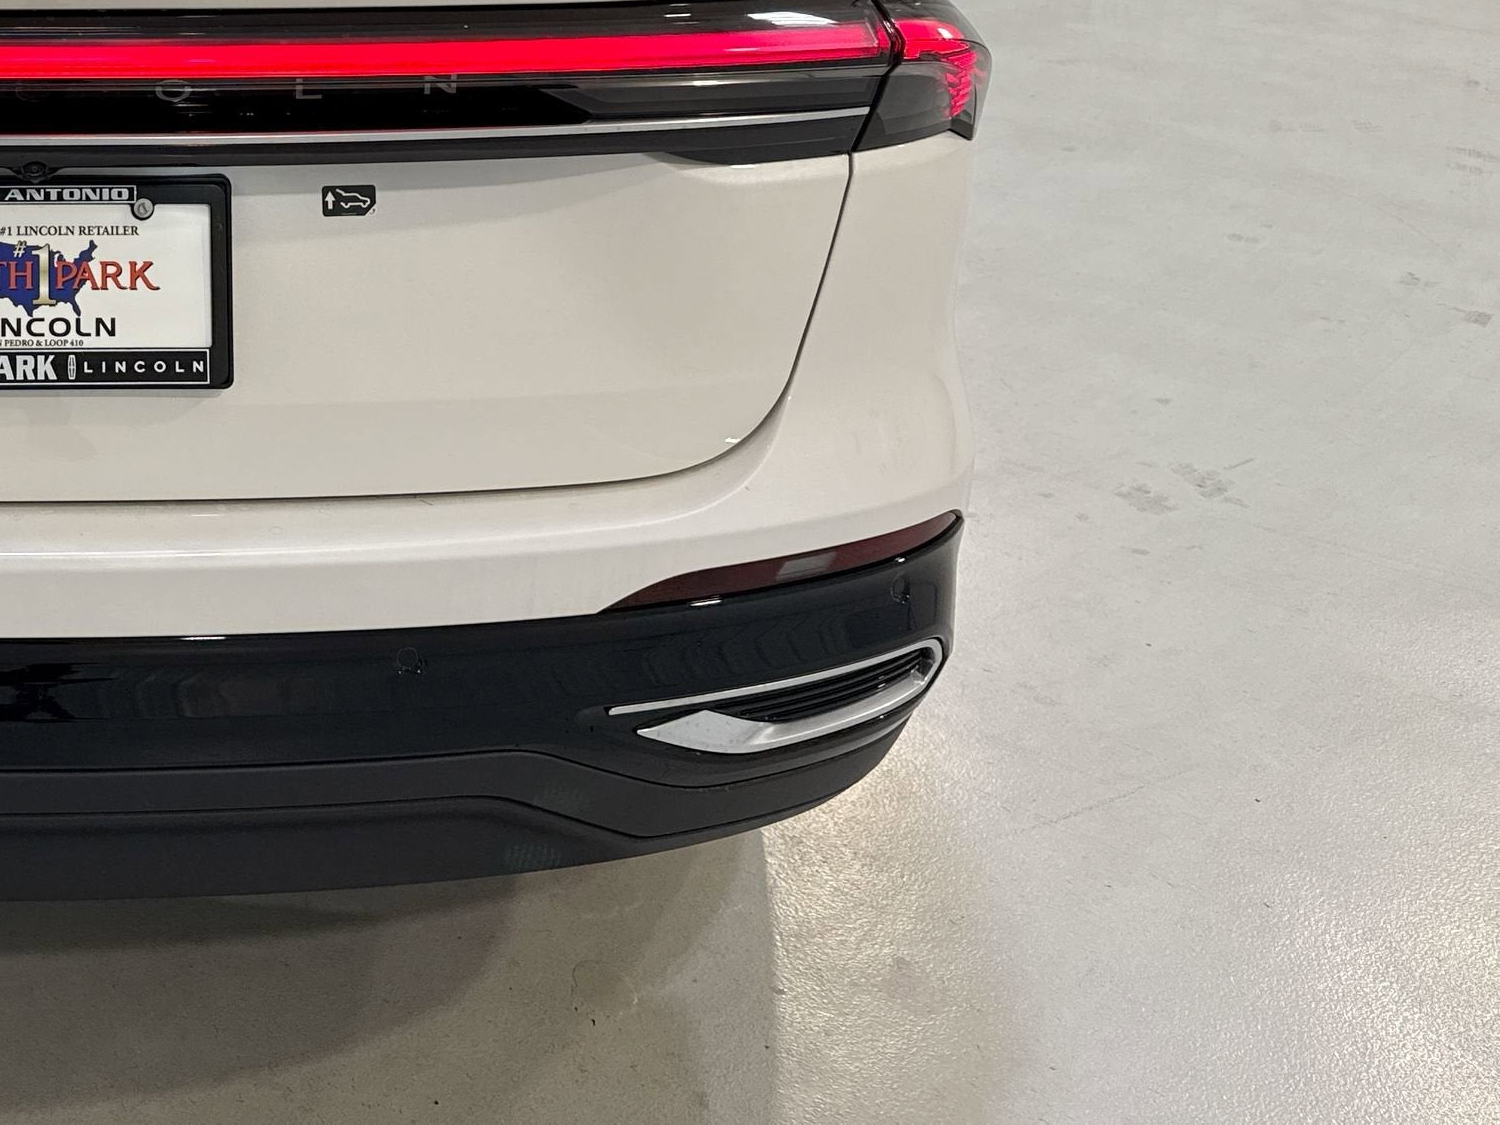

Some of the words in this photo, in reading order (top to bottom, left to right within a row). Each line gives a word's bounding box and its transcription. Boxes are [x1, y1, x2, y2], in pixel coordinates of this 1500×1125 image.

[4, 188, 130, 202] ANTONIO
[0, 226, 13, 237] #1
[16, 225, 75, 237] LINCOLN
[78, 225, 140, 237] RETAILER
[55, 260, 161, 292] PARK
[4, 339, 34, 347] PEDRO
[35, 339, 43, 347] &
[44, 339, 69, 347] LOOP
[70, 339, 84, 347] 410
[83, 360, 204, 374] LINCOLN
